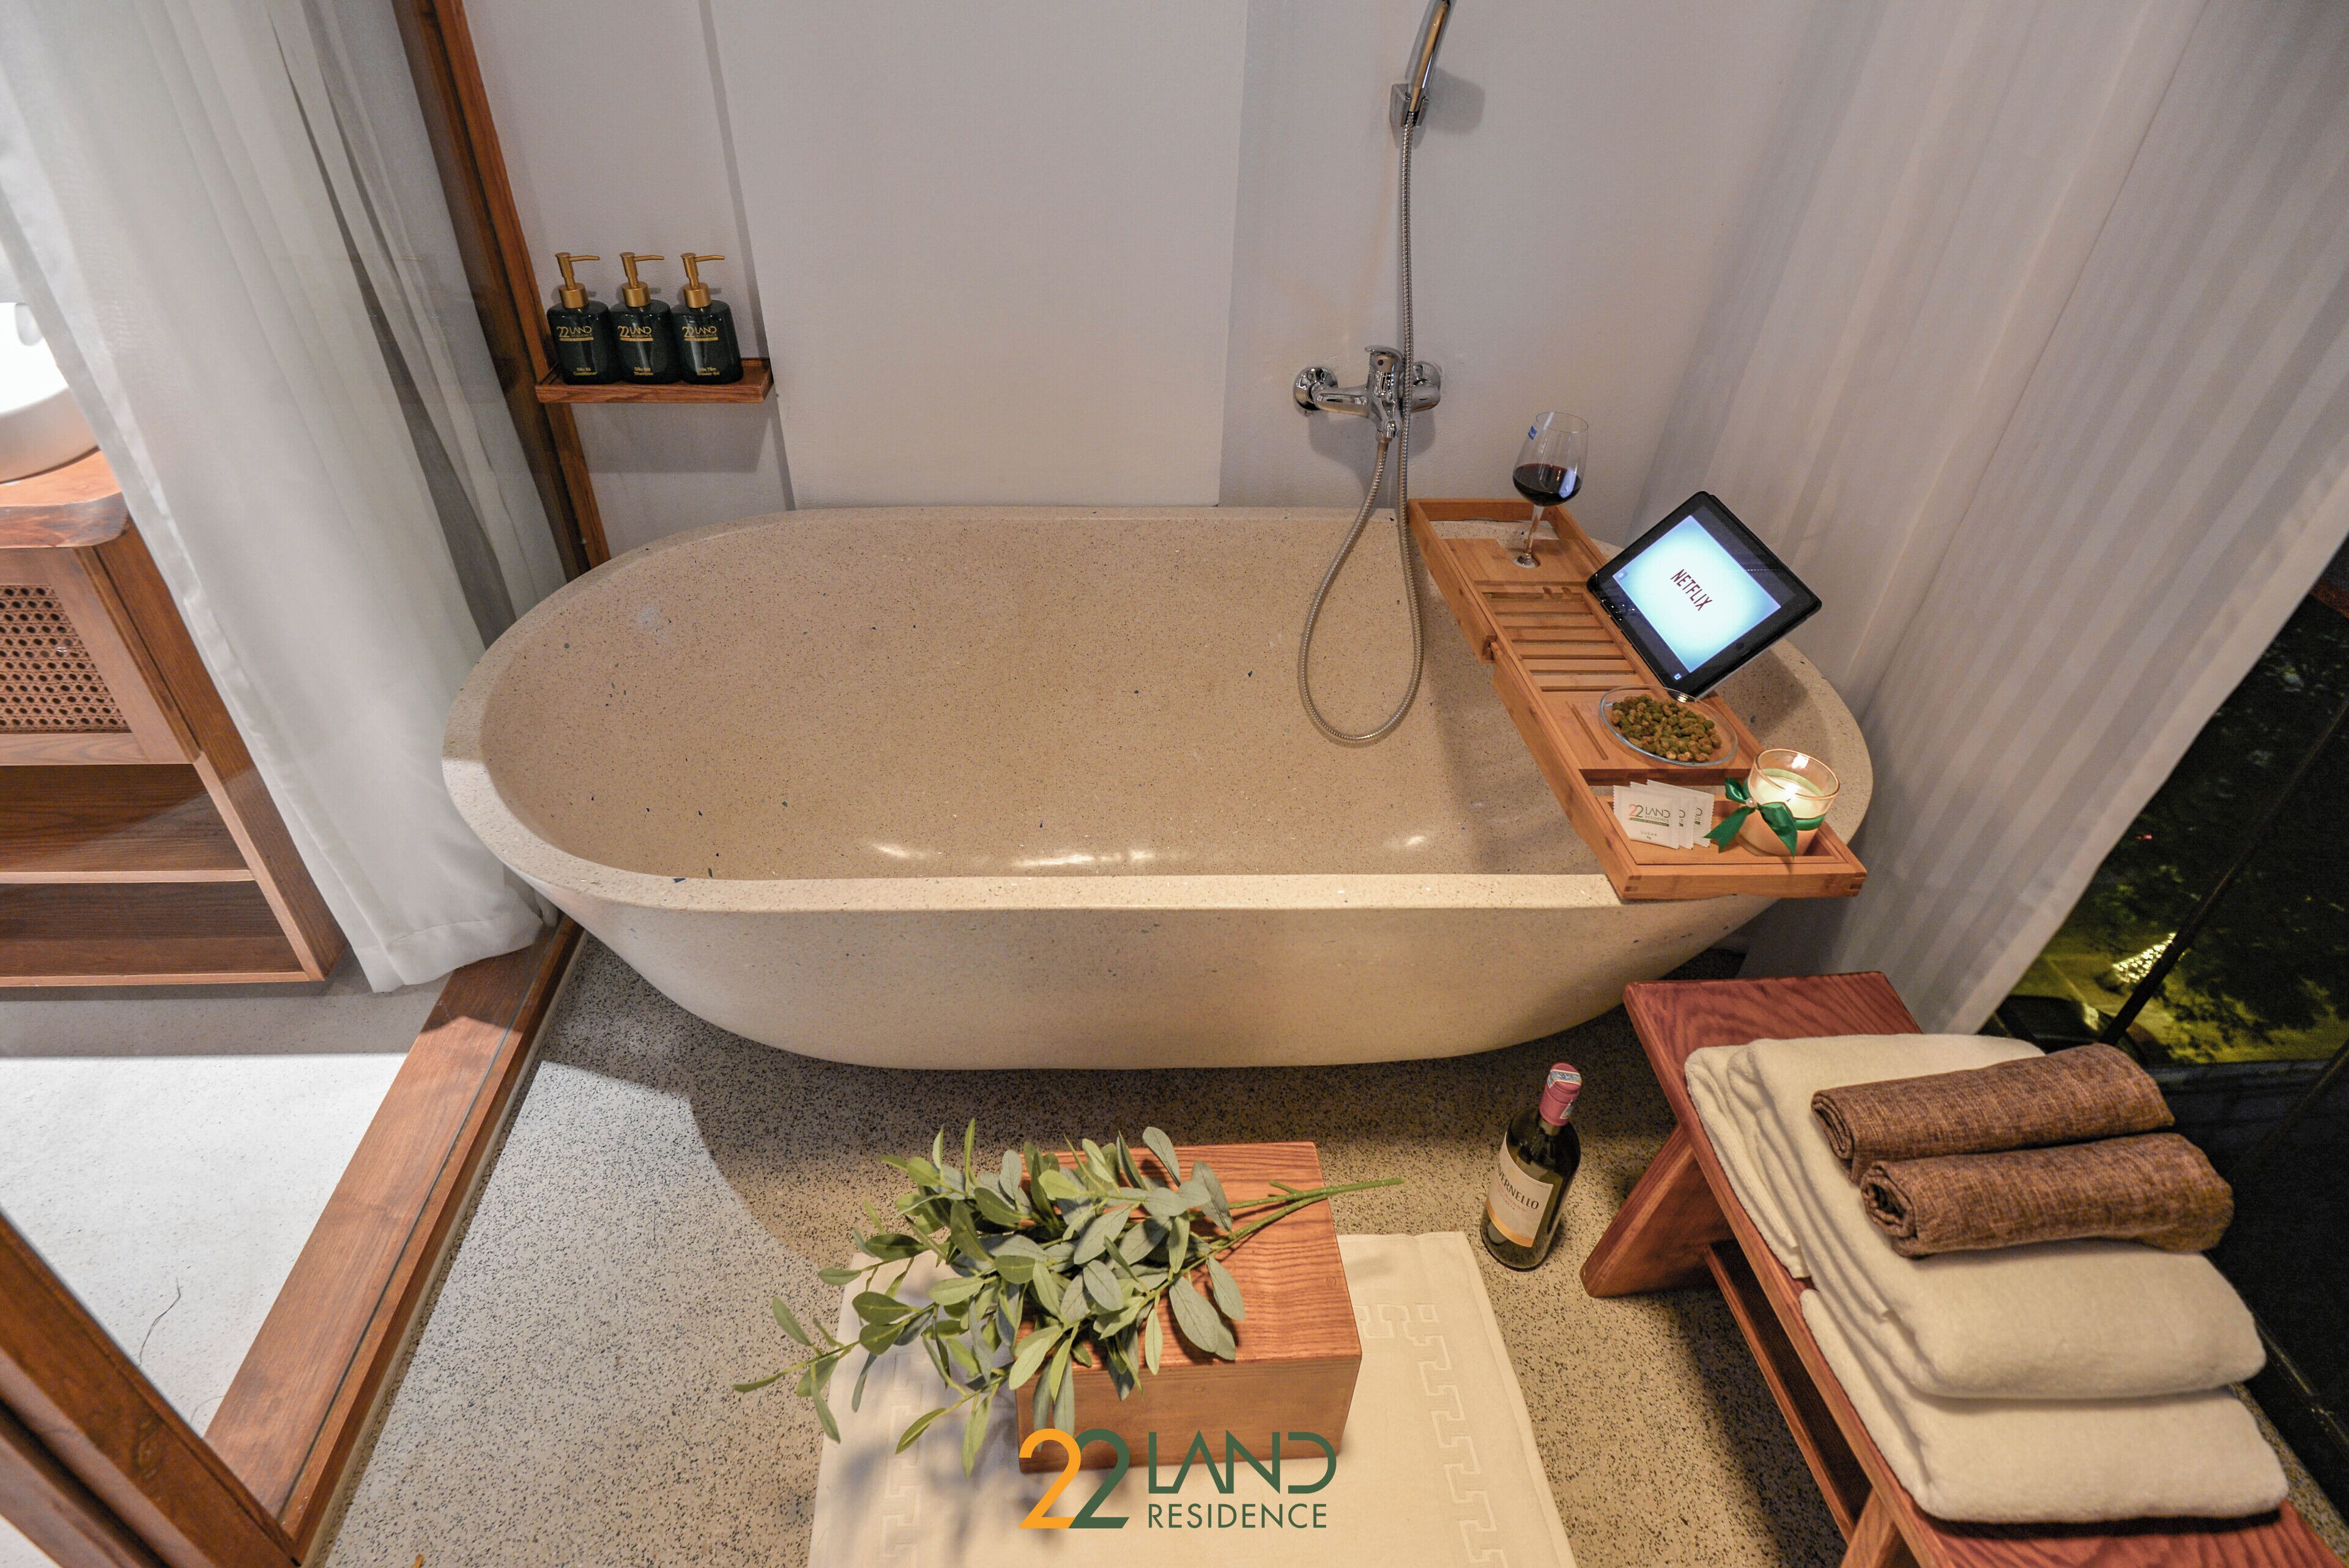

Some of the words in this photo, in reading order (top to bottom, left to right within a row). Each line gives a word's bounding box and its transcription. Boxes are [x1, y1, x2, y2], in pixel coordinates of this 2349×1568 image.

[557, 326, 570, 337] 22
[569, 325, 592, 334] LAND
[618, 325, 630, 337] 22
[682, 326, 695, 337] 22
[1670, 569, 1713, 611] NETFLIX
[1628, 804, 1644, 818] 22
[1645, 806, 1671, 818] LAND
